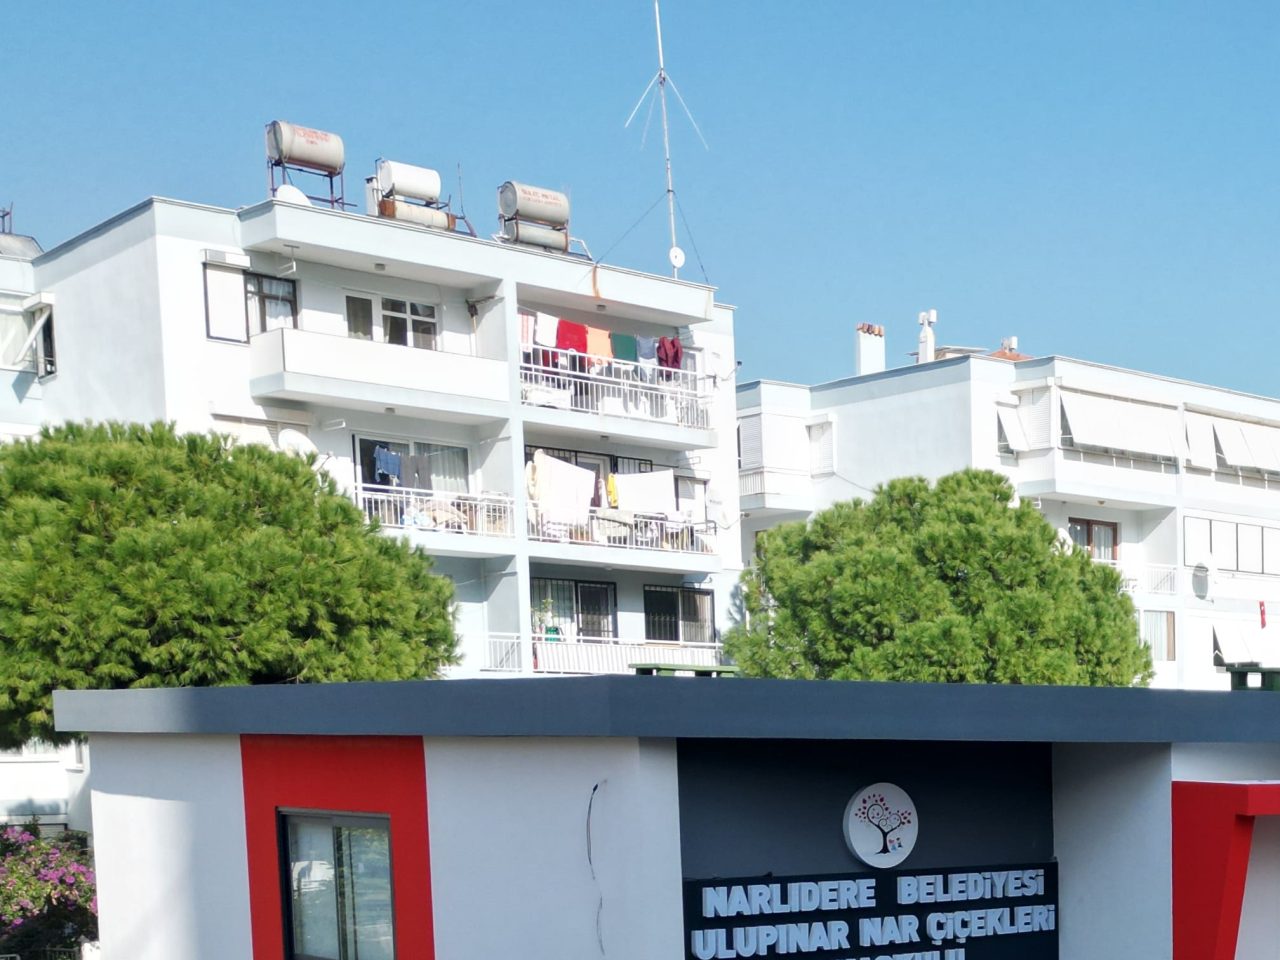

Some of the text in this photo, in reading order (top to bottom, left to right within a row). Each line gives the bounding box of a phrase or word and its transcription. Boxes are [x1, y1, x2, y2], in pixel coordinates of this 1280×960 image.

[702, 869, 1045, 918] NARLIDERE BELEDİYESİ
[691, 904, 1056, 960] ULUPINAR NAR ÇİÇEKLERİ
